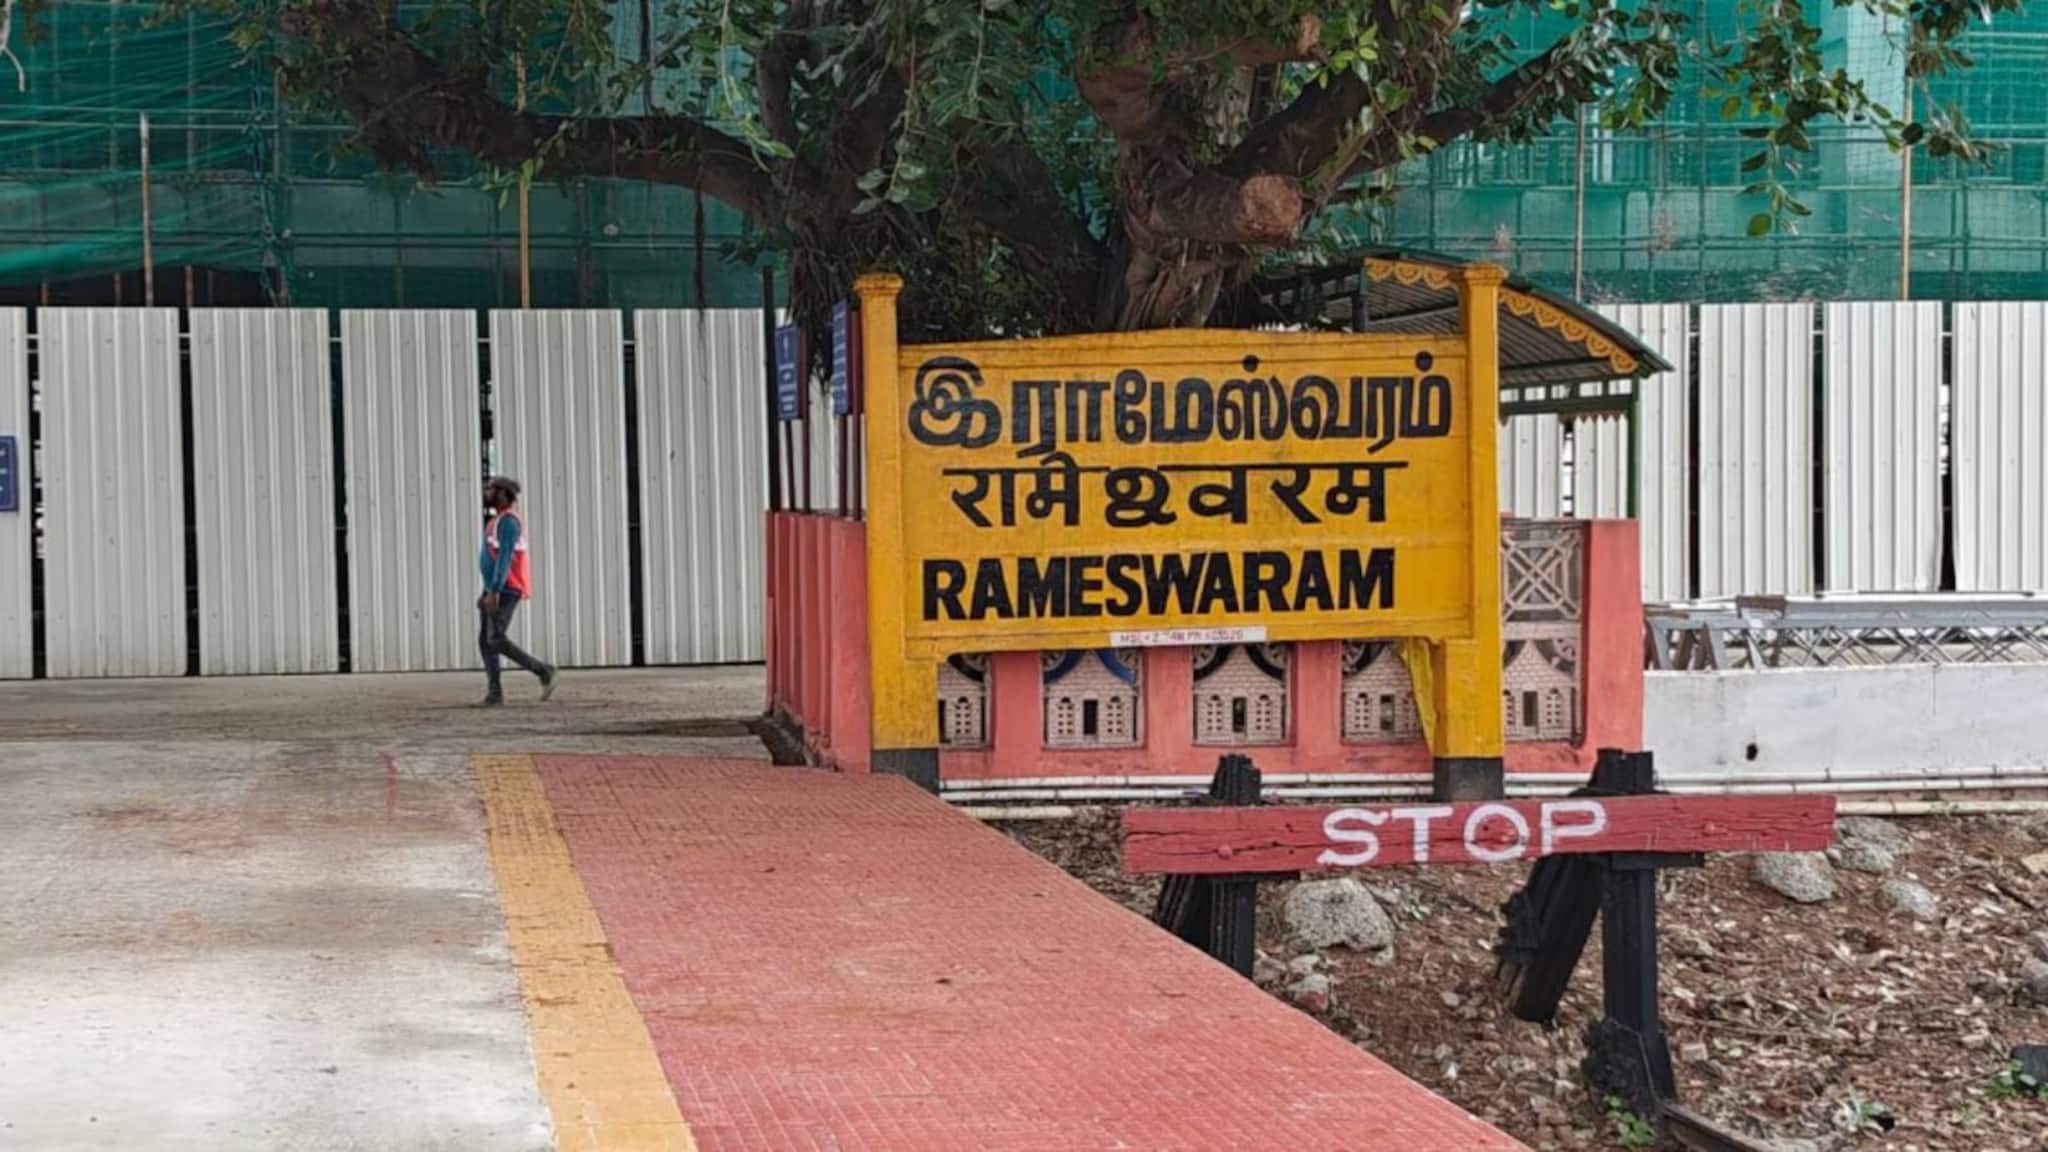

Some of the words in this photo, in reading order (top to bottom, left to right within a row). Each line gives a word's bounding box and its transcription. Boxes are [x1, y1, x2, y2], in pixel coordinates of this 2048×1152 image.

[908, 352, 1452, 458] இராமேஸ்வரம்
[924, 548, 1395, 620] RAMESWARAM
[1317, 799, 1607, 867] STOP
